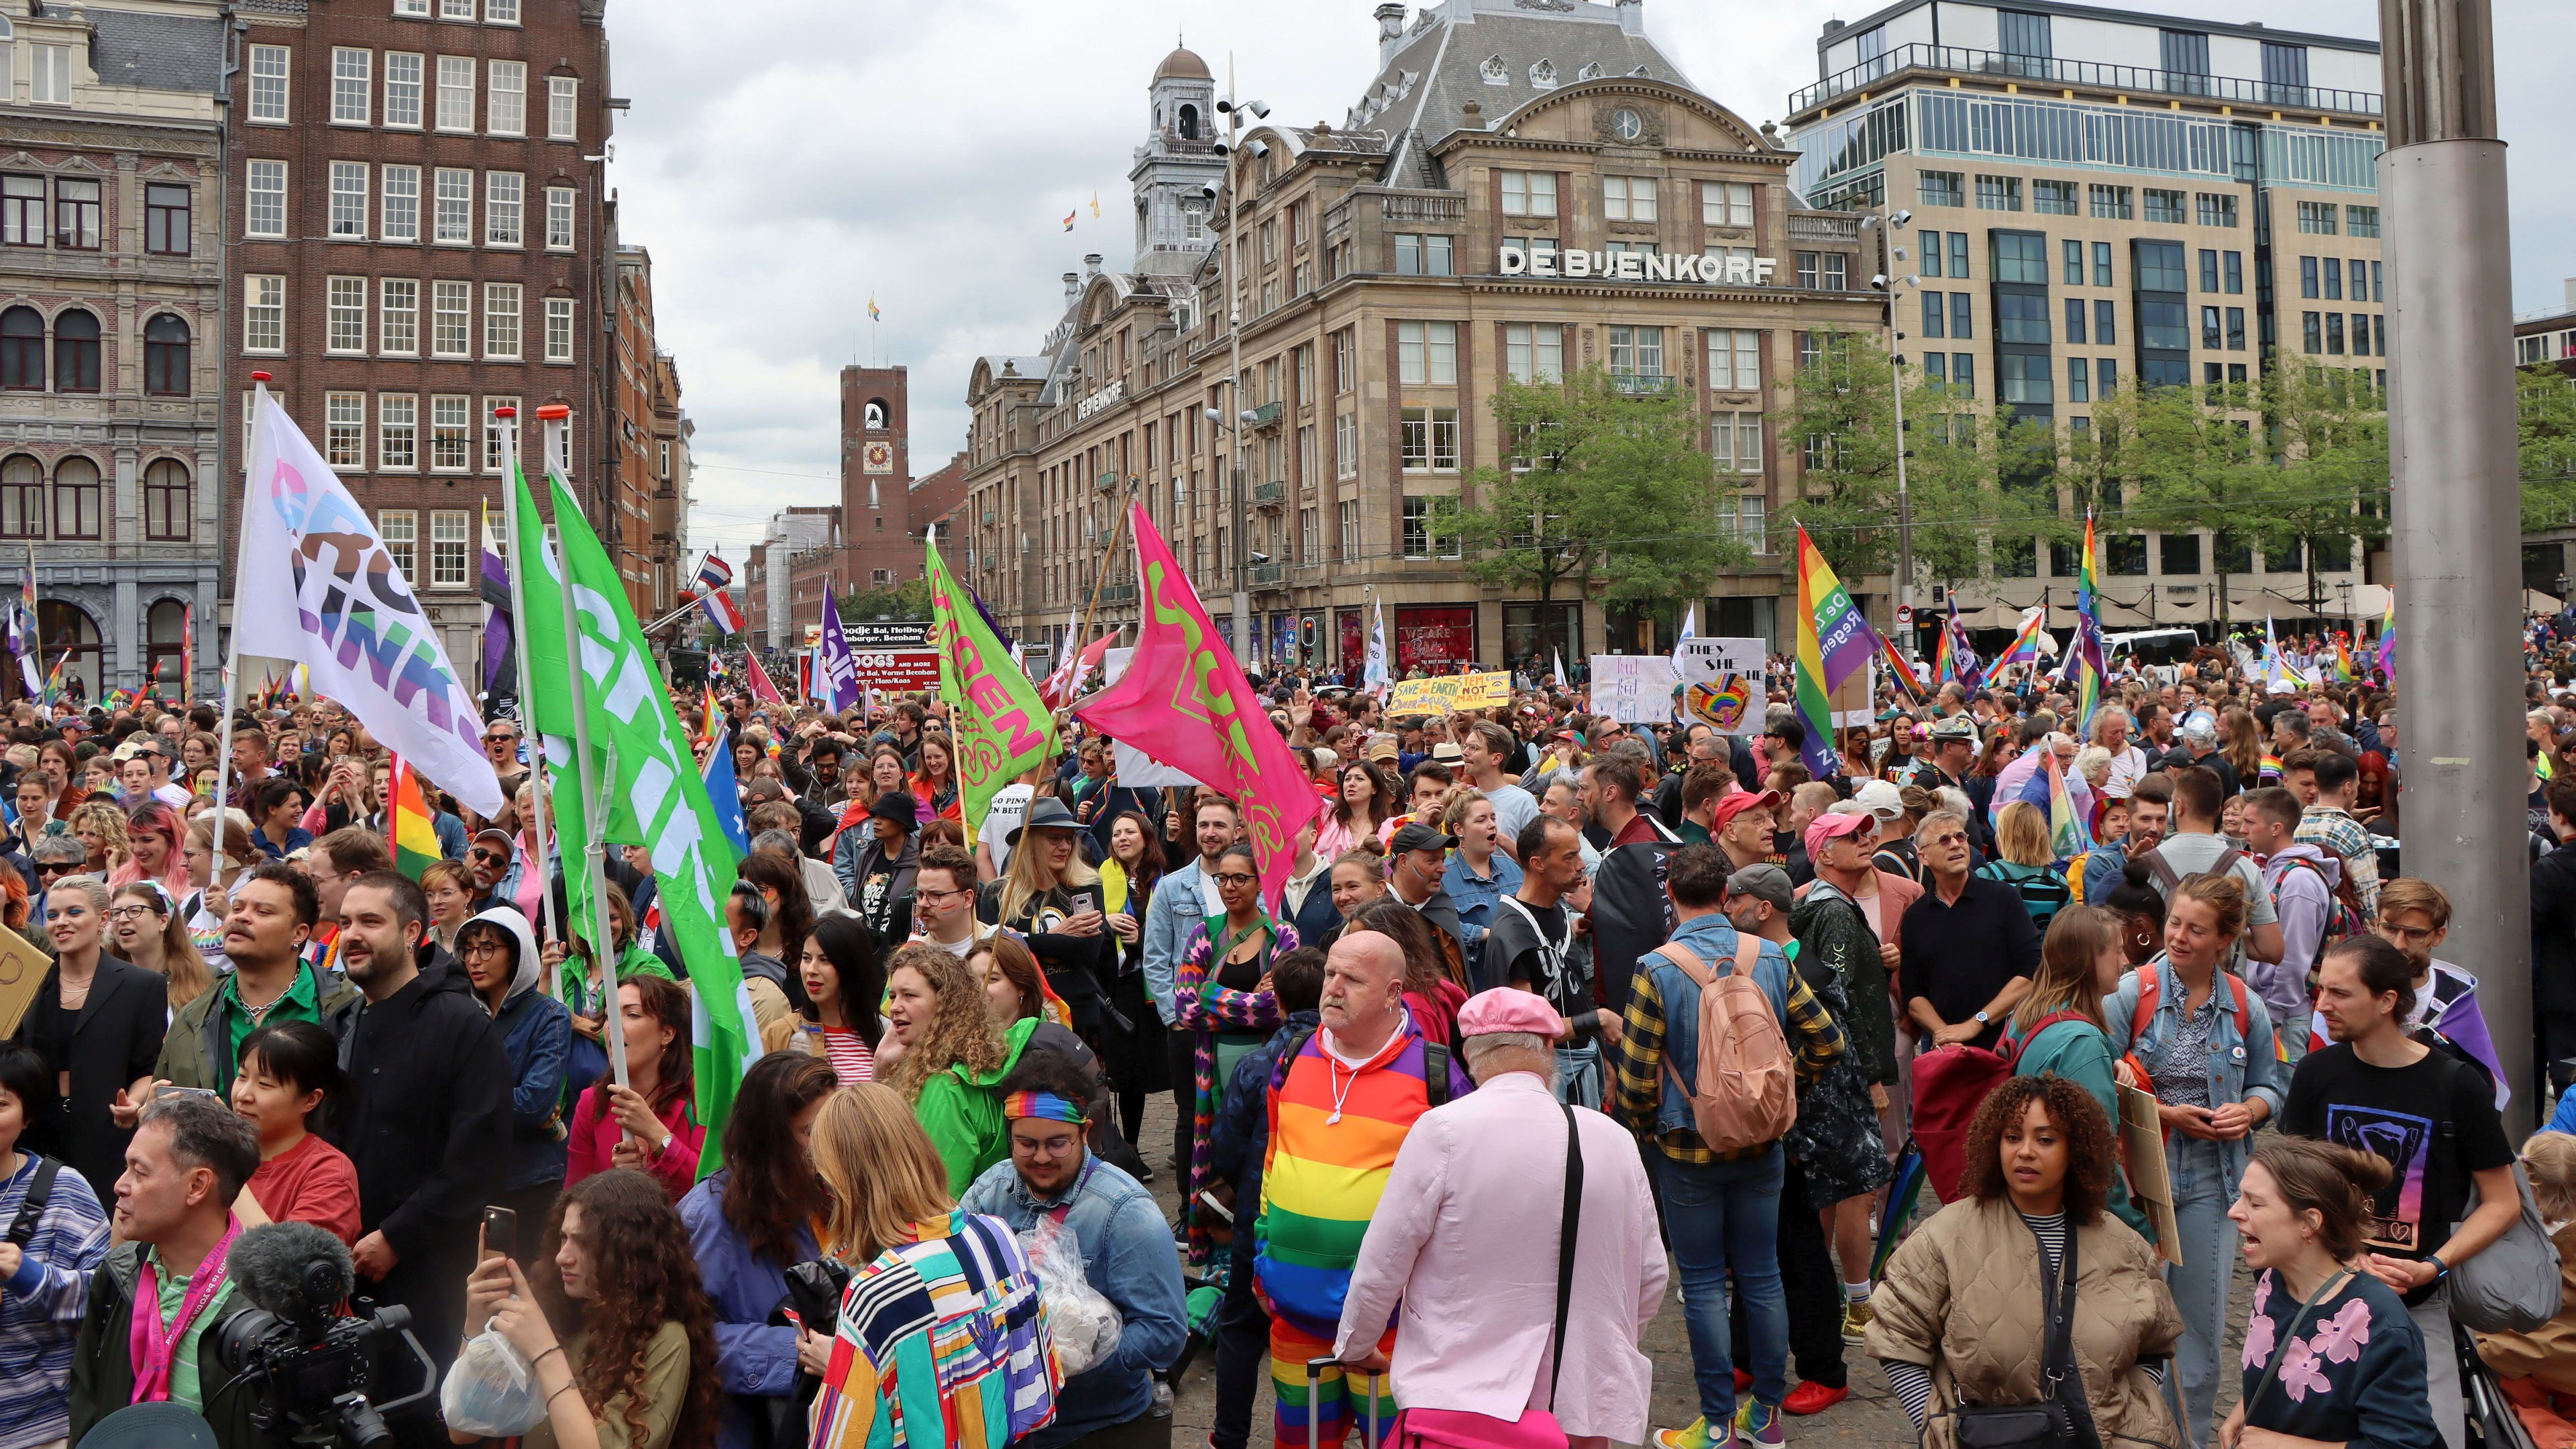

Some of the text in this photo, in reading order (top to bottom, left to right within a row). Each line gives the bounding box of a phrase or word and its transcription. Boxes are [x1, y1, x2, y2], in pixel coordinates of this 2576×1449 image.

[1500, 246, 1776, 284] DE BIJENKORF
[1077, 400, 1087, 422] DE
[1688, 644, 1728, 658] THEY
[1705, 658, 1739, 670] SHE
[1746, 669, 1763, 681] HE
[1394, 682, 1420, 698] SAVE
[1430, 681, 1458, 697] EARTH
[1462, 685, 1487, 695] NOT
